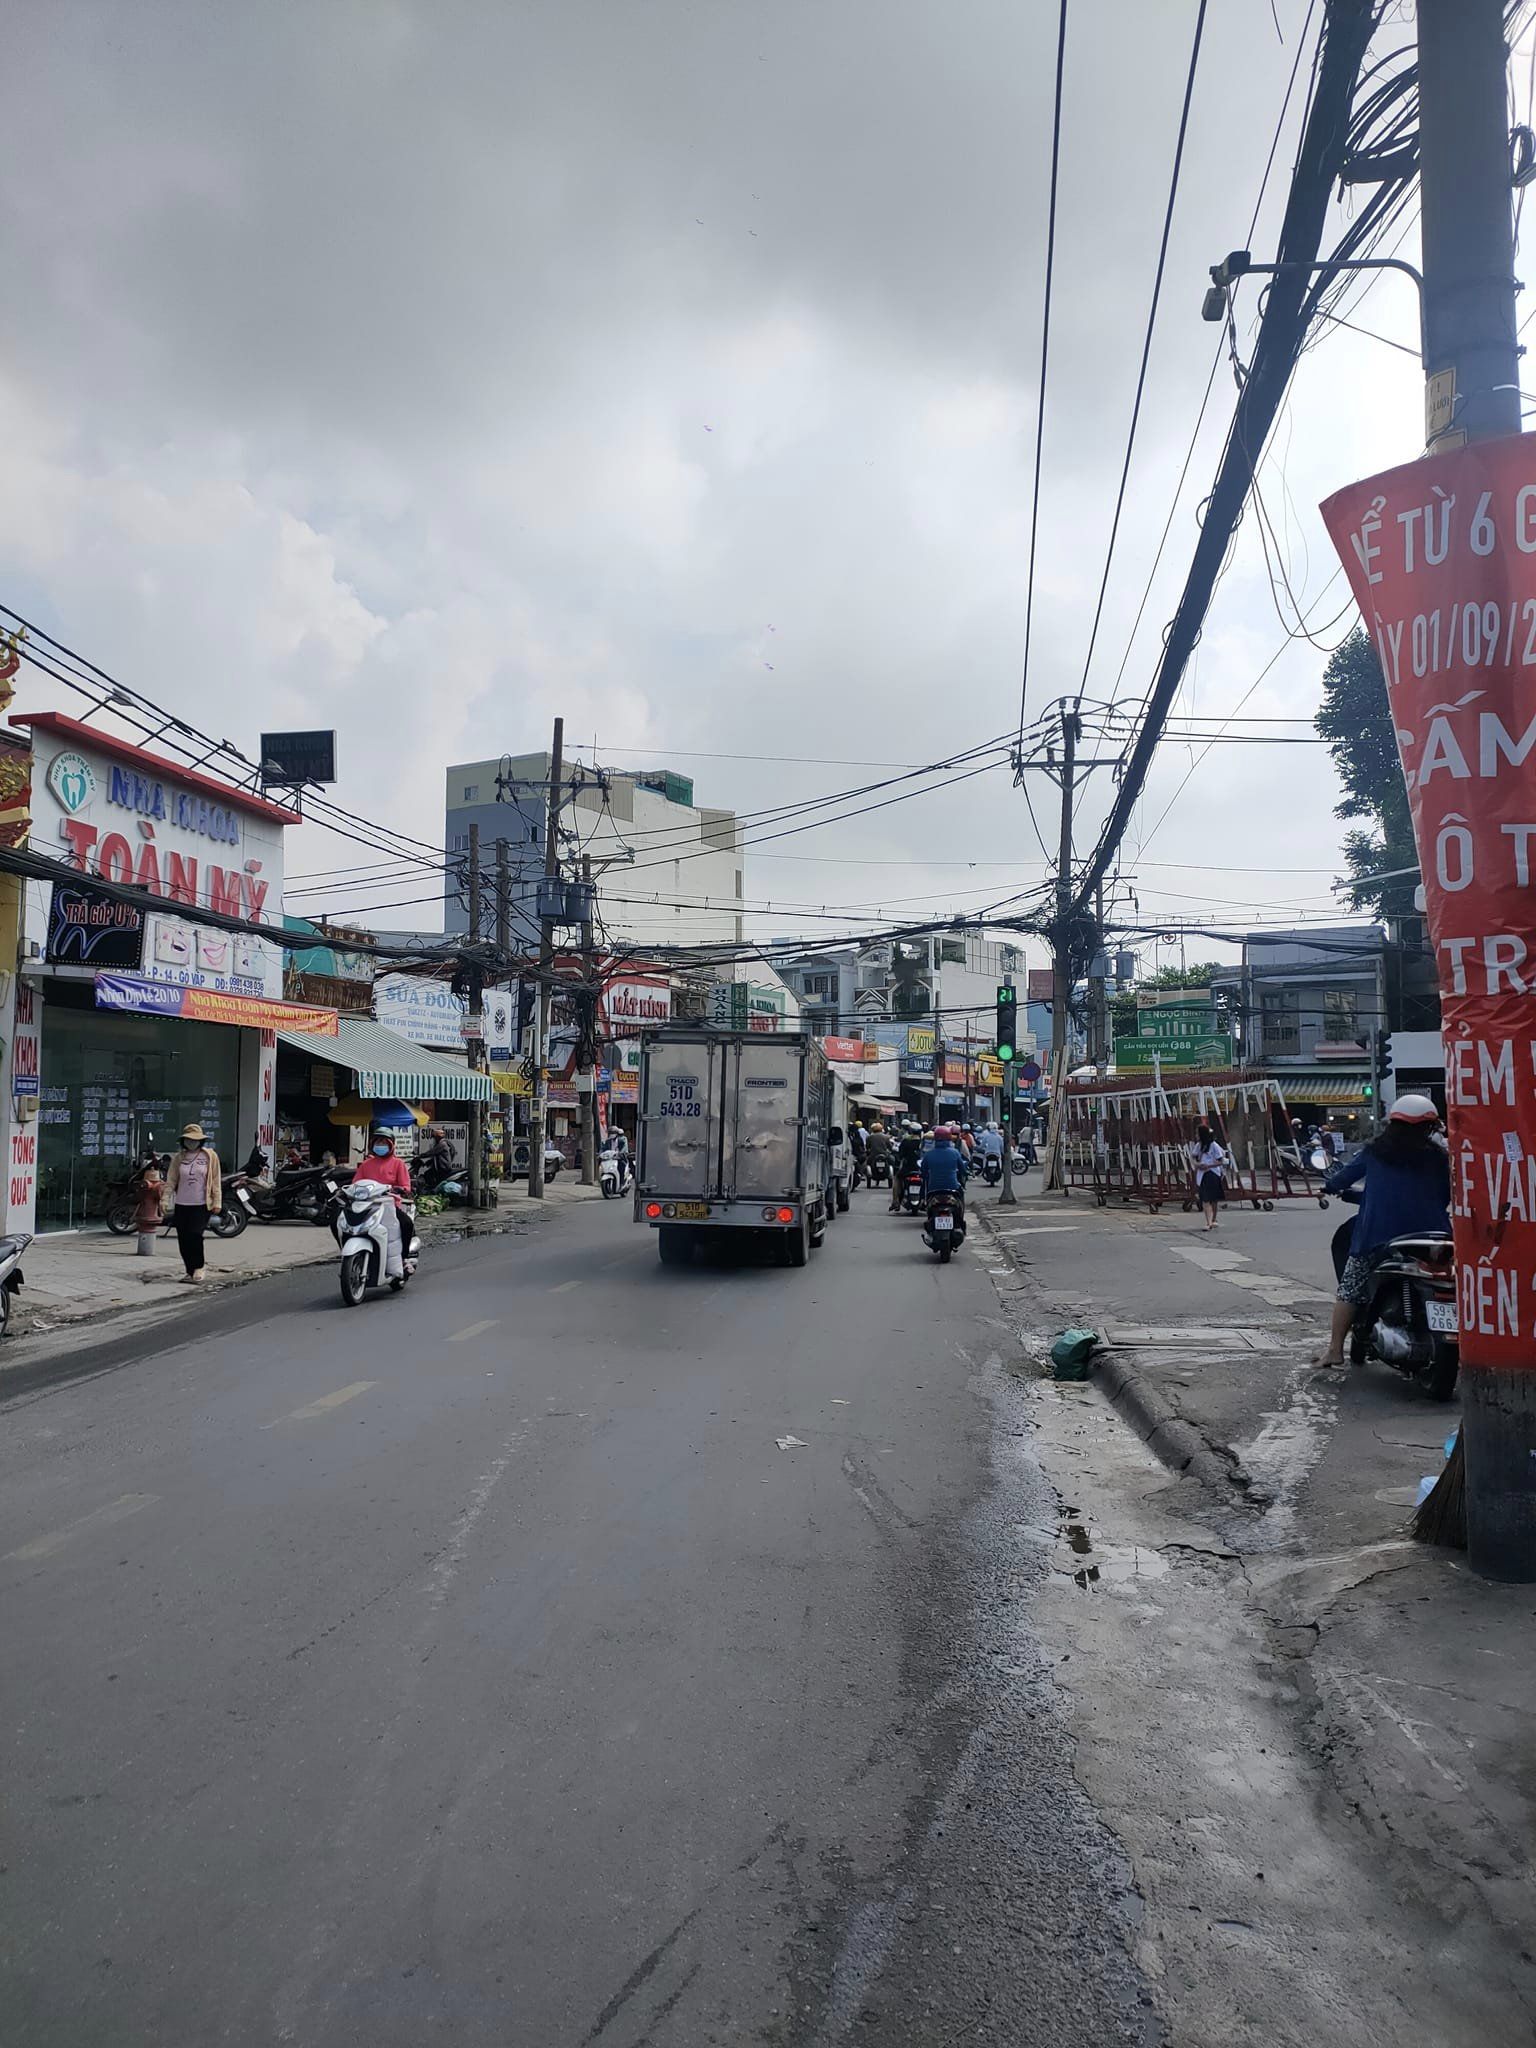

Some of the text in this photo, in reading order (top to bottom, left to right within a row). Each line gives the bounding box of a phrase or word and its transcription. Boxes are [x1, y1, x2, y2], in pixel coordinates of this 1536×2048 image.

[1396, 485, 1456, 574] TỪ
[1470, 491, 1496, 557] 6
[107, 765, 240, 846] NHA KHOA
[1436, 811, 1475, 893] Ô
[60, 817, 270, 923] TOÀN MỸ
[66, 897, 89, 924] TRẢ
[153, 987, 181, 1003] 20/10
[612, 987, 669, 1018] MẮT KÍNH
[1000, 989, 1012, 1002] 21
[13, 1036, 38, 1076] KHOA
[917, 1037, 935, 1051] JOTU
[669, 1086, 693, 1100] 51D
[746, 1079, 785, 1087] FRONTIER
[660, 1102, 701, 1117] 543.28
[12, 1124, 35, 1166] TỔNG
[1462, 1246, 1520, 1337] ĐẾN
[1431, 1316, 1458, 1330] 266
[1432, 1304, 1457, 1318] 59-V
